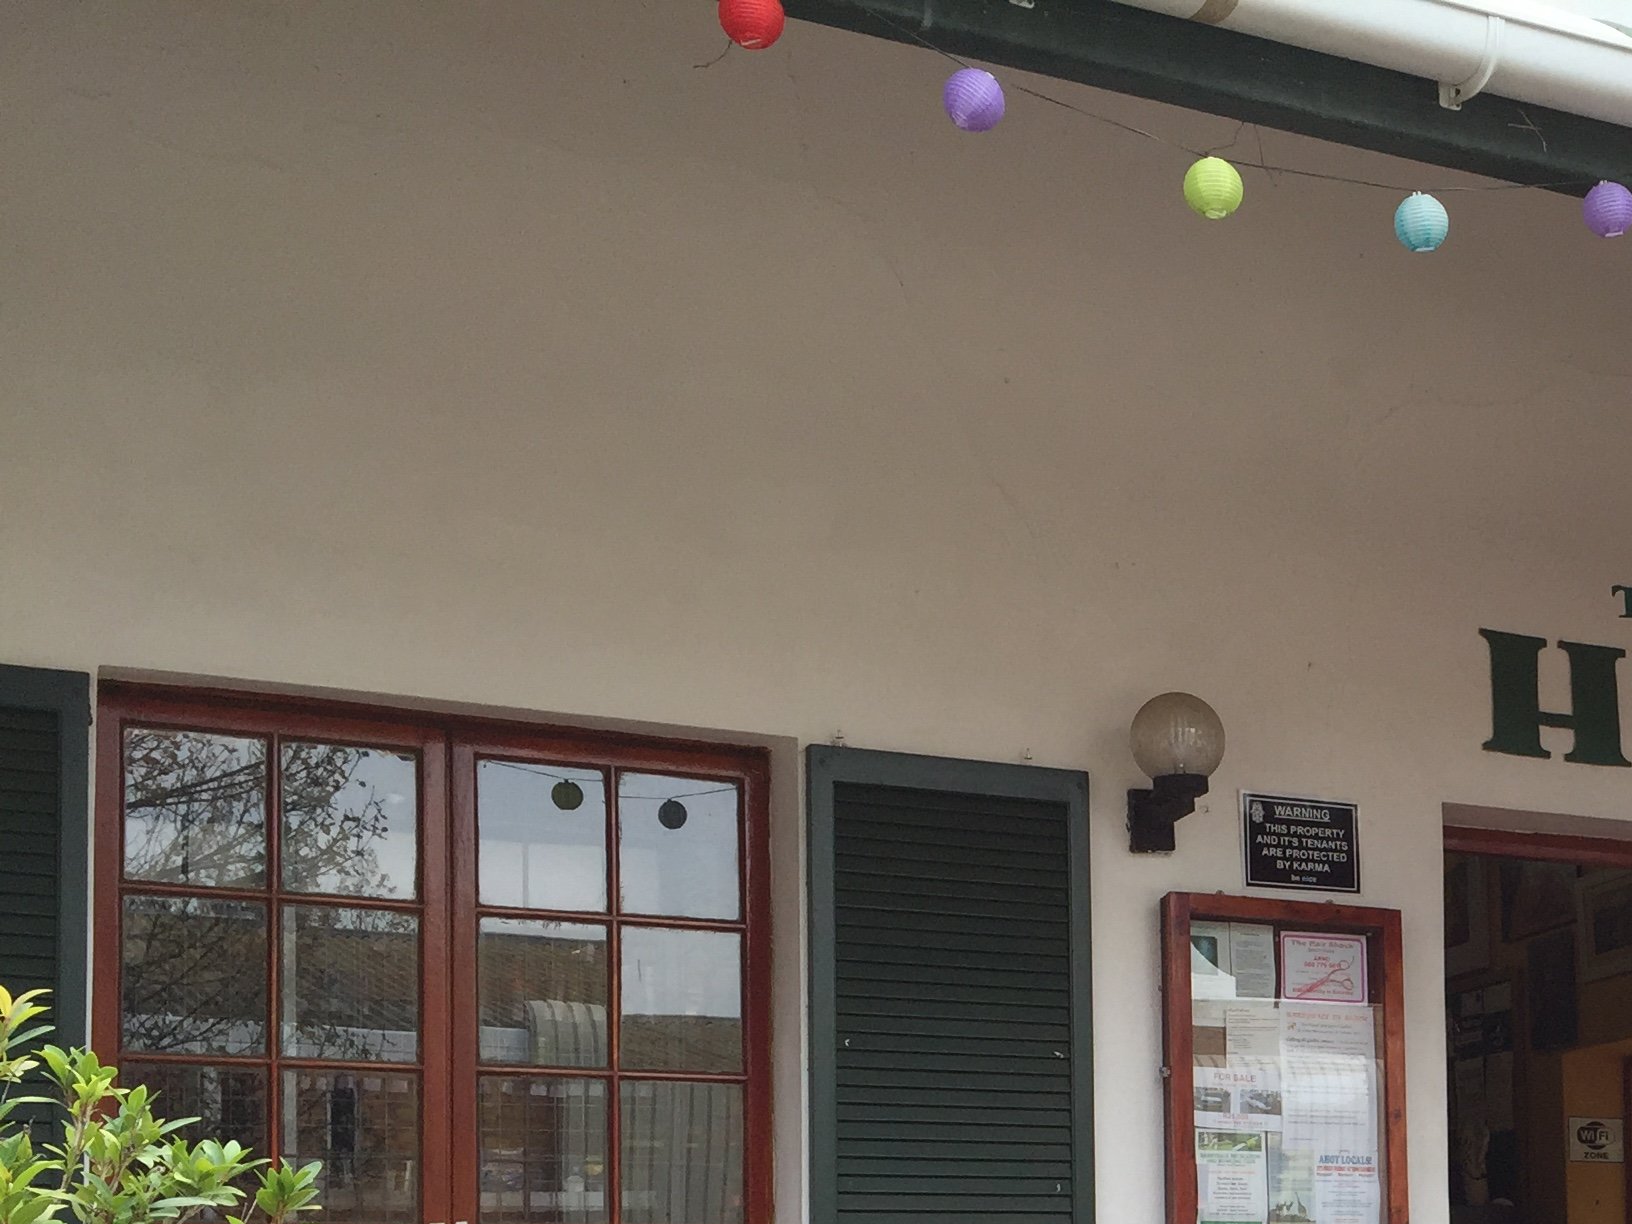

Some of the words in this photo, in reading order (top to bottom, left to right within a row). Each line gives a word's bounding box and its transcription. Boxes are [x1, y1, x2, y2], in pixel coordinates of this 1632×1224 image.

[1274, 805, 1331, 821] WARNING
[1265, 823, 1288, 834] THIS
[1290, 825, 1344, 838] PROPERTY
[1256, 835, 1278, 844] AND
[1280, 837, 1298, 846] IT'S
[1301, 838, 1348, 851] TENANTS
[1262, 847, 1283, 857] ARE
[1286, 849, 1347, 862] PROTECTED
[1276, 860, 1291, 870] BY
[1293, 861, 1331, 873] KARMA
[1583, 1151, 1609, 1160] ZONE
